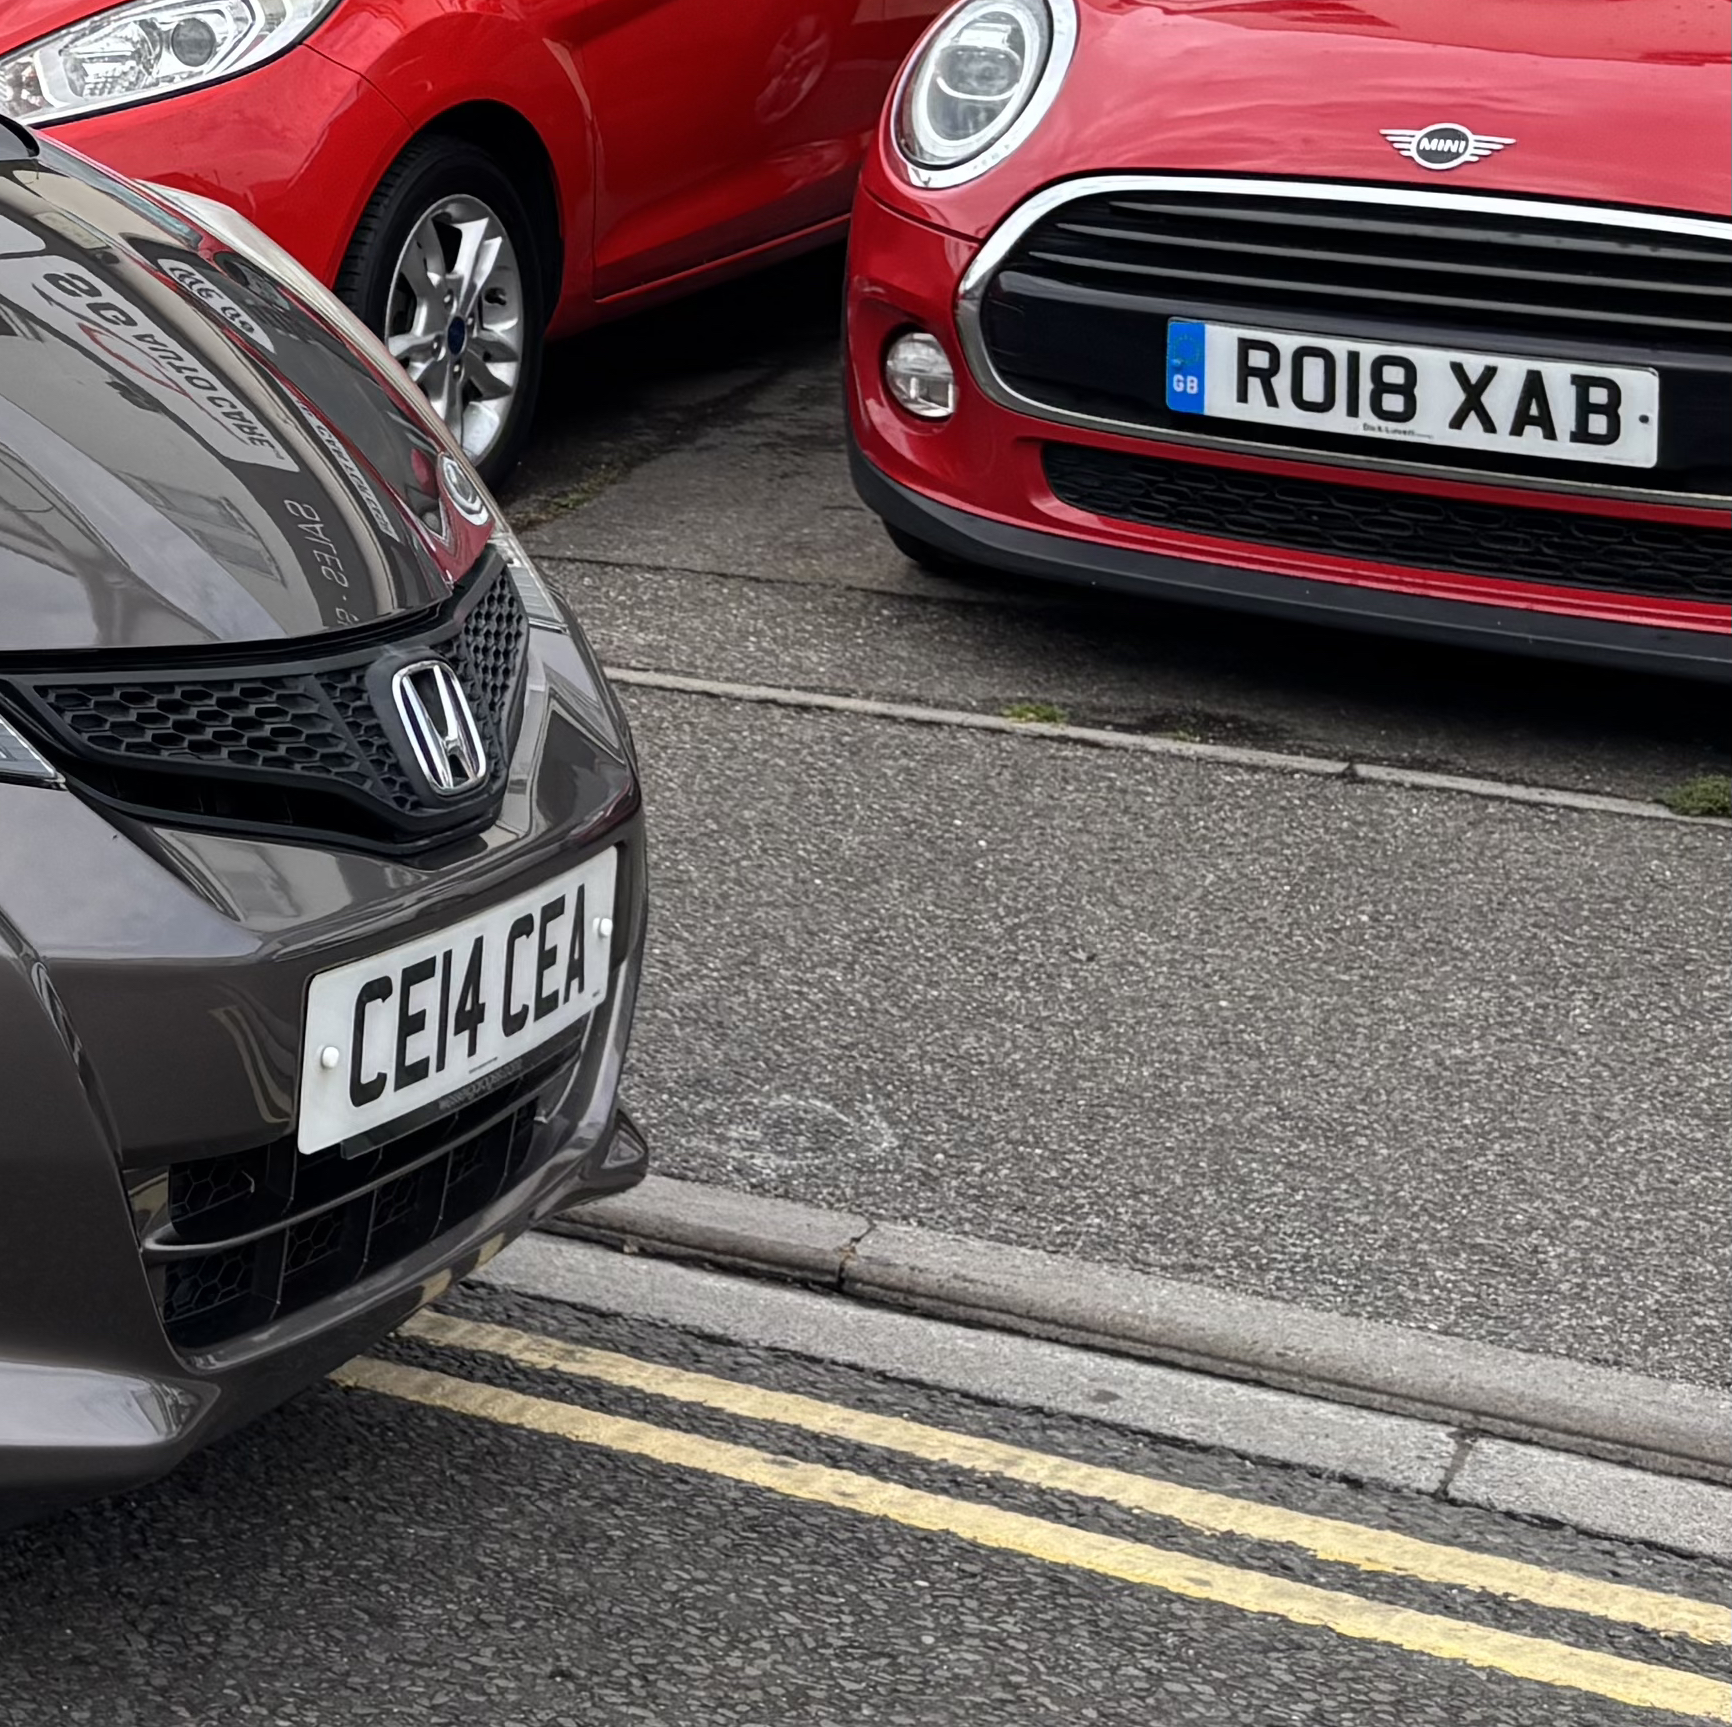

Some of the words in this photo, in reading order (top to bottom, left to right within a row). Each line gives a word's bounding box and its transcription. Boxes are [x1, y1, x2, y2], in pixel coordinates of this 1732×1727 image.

[1418, 136, 1467, 154] MINI
[1172, 374, 1199, 395] GB
[1236, 336, 1418, 424] RO18
[1448, 360, 1623, 447] XAB
[348, 934, 487, 1108] CE14
[500, 882, 586, 1038] CEA
